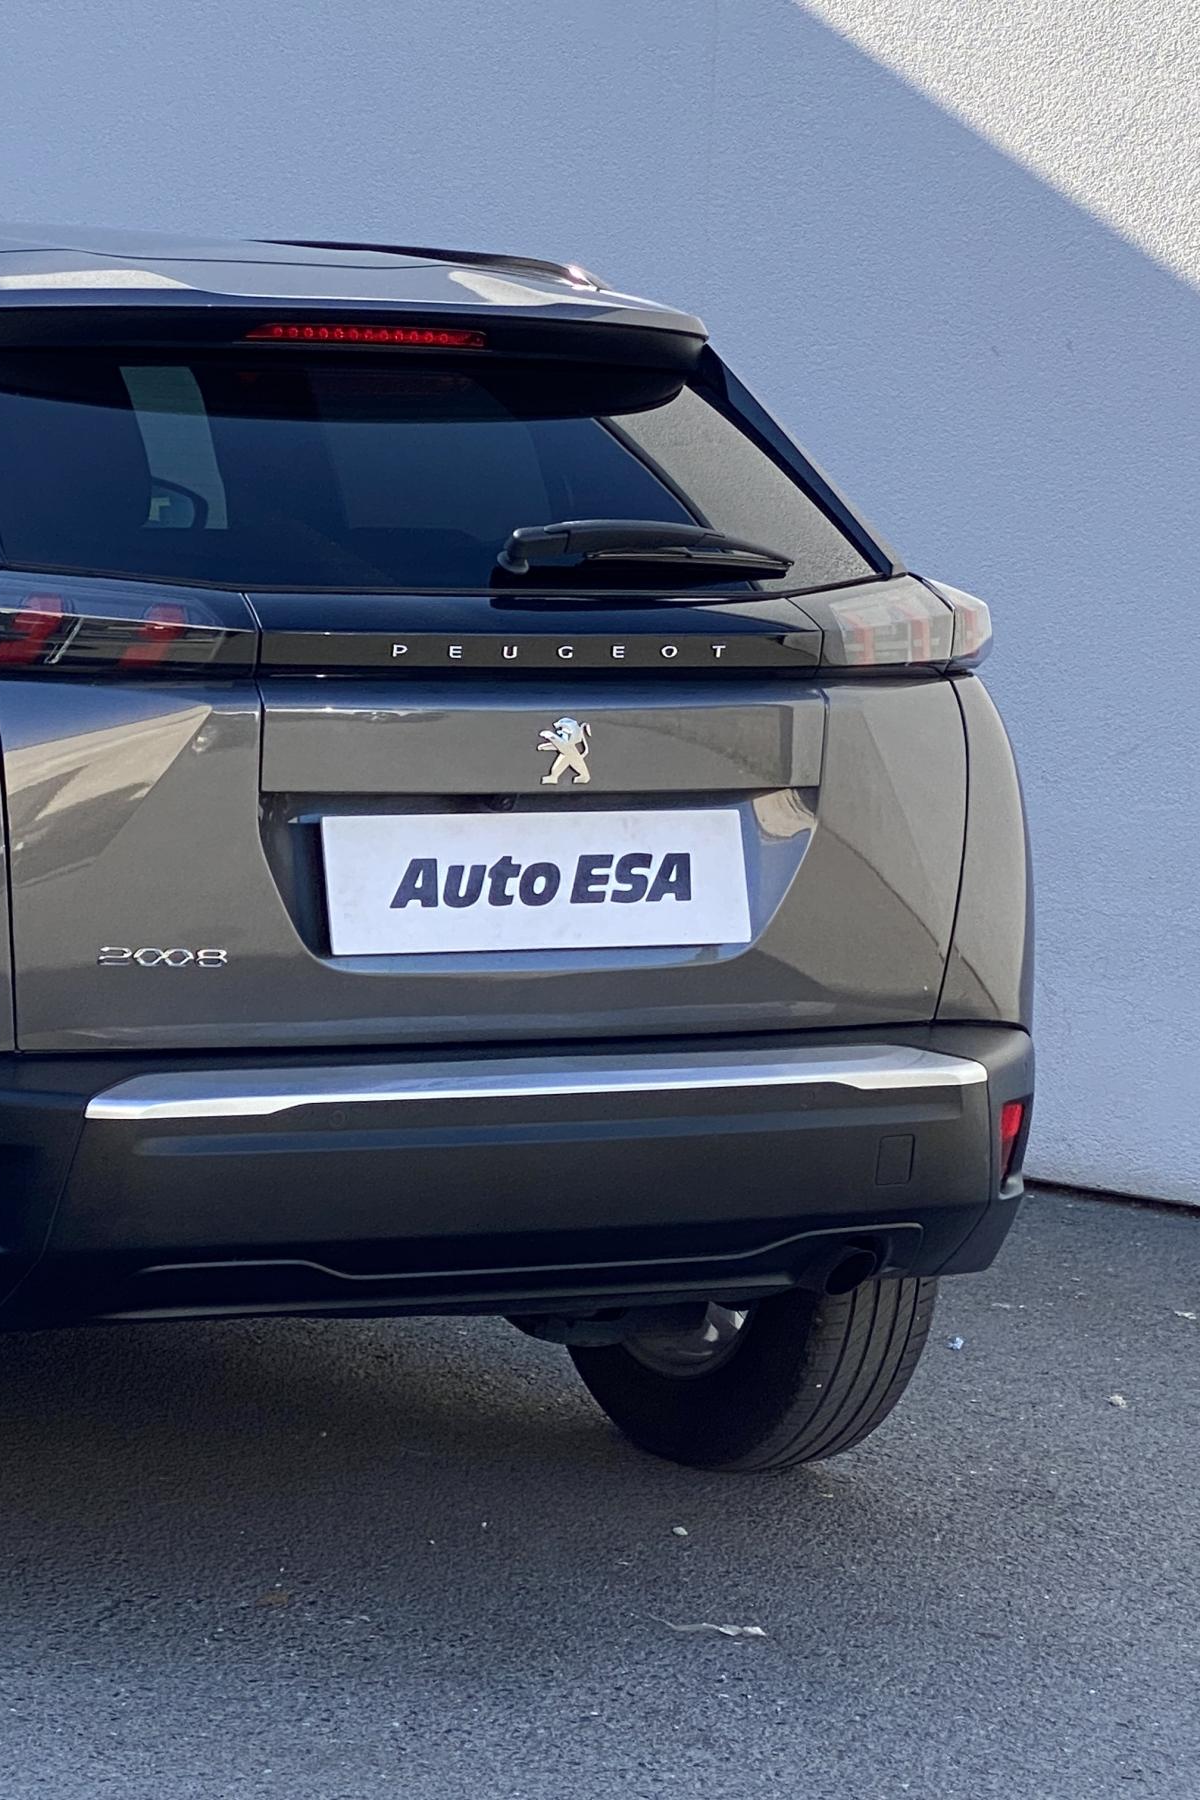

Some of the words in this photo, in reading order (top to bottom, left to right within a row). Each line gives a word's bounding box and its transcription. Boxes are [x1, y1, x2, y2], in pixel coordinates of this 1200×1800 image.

[391, 643, 727, 660] PEUGEOT
[389, 855, 561, 909] Auto
[569, 852, 692, 904] ESA
[97, 946, 228, 968] 2008
